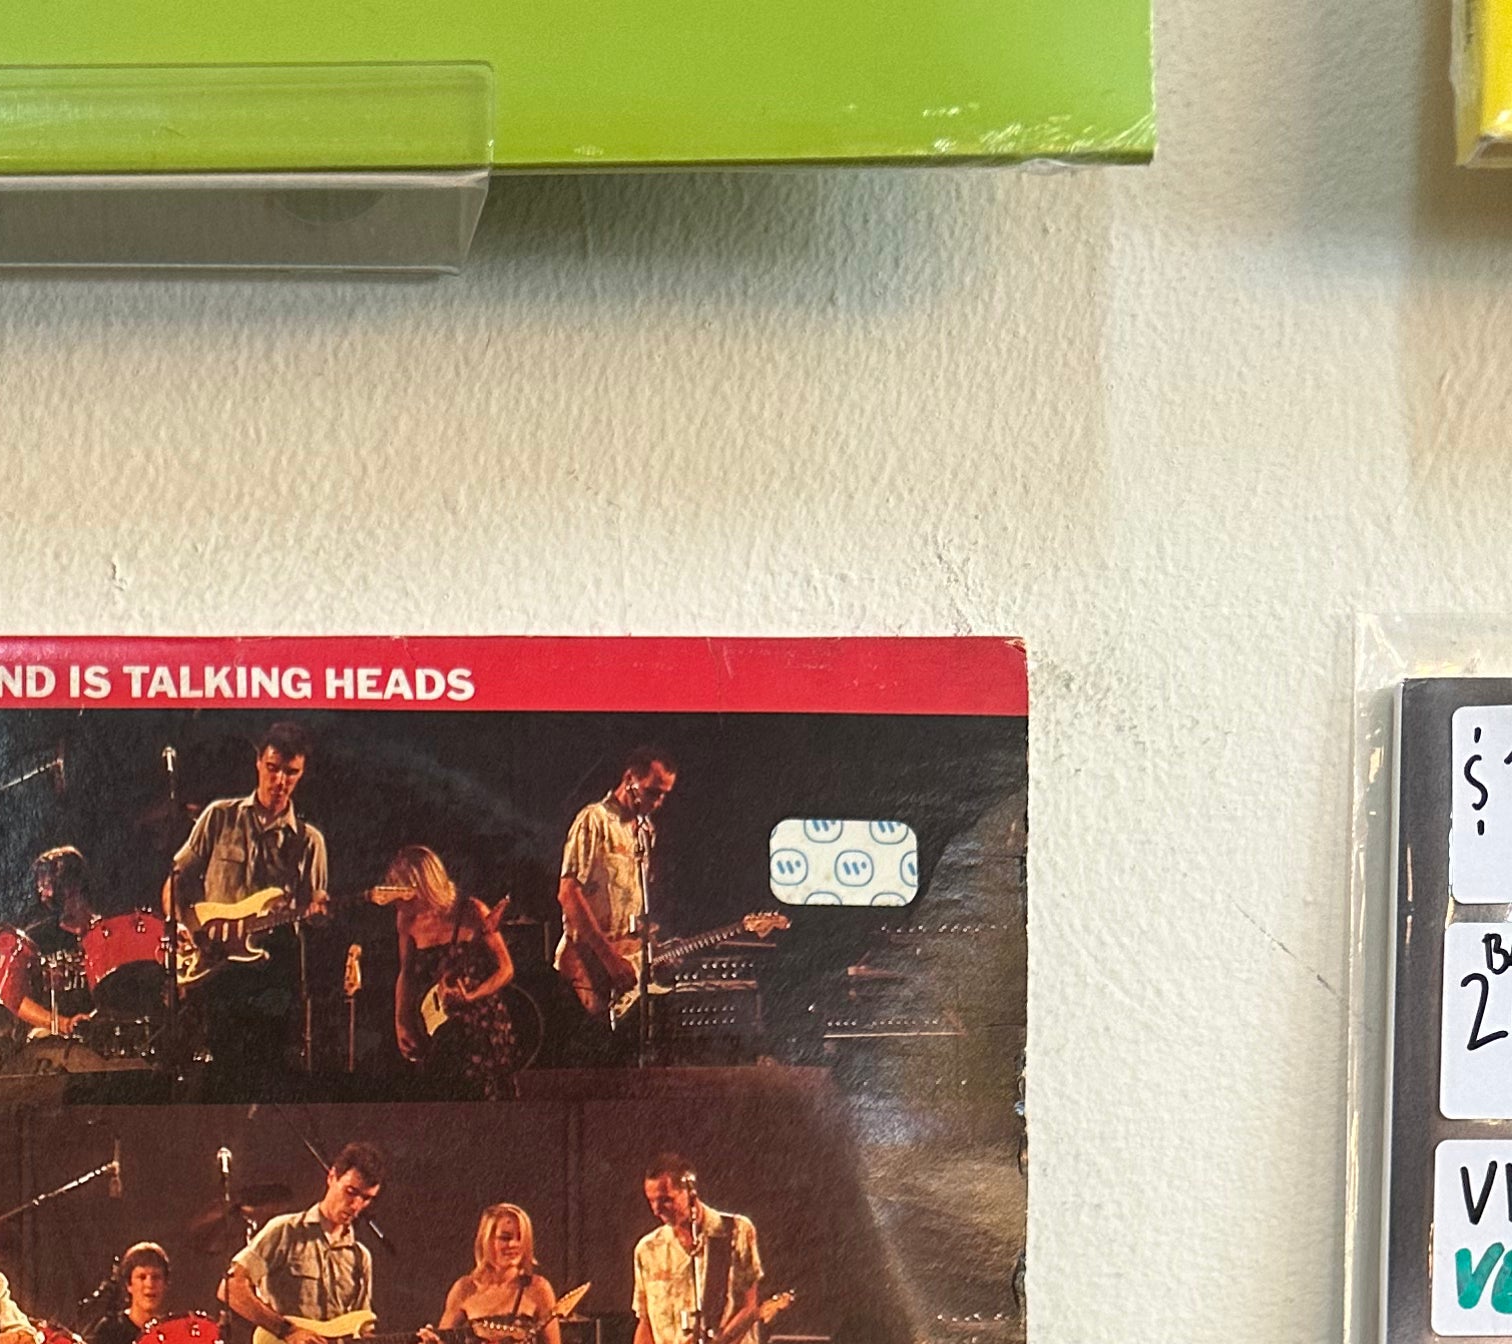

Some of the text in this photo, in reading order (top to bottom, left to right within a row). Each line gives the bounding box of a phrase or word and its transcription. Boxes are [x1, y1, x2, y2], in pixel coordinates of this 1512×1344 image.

[68, 664, 112, 700] IS
[122, 665, 313, 700] TALKING
[325, 667, 477, 702] HEADS
